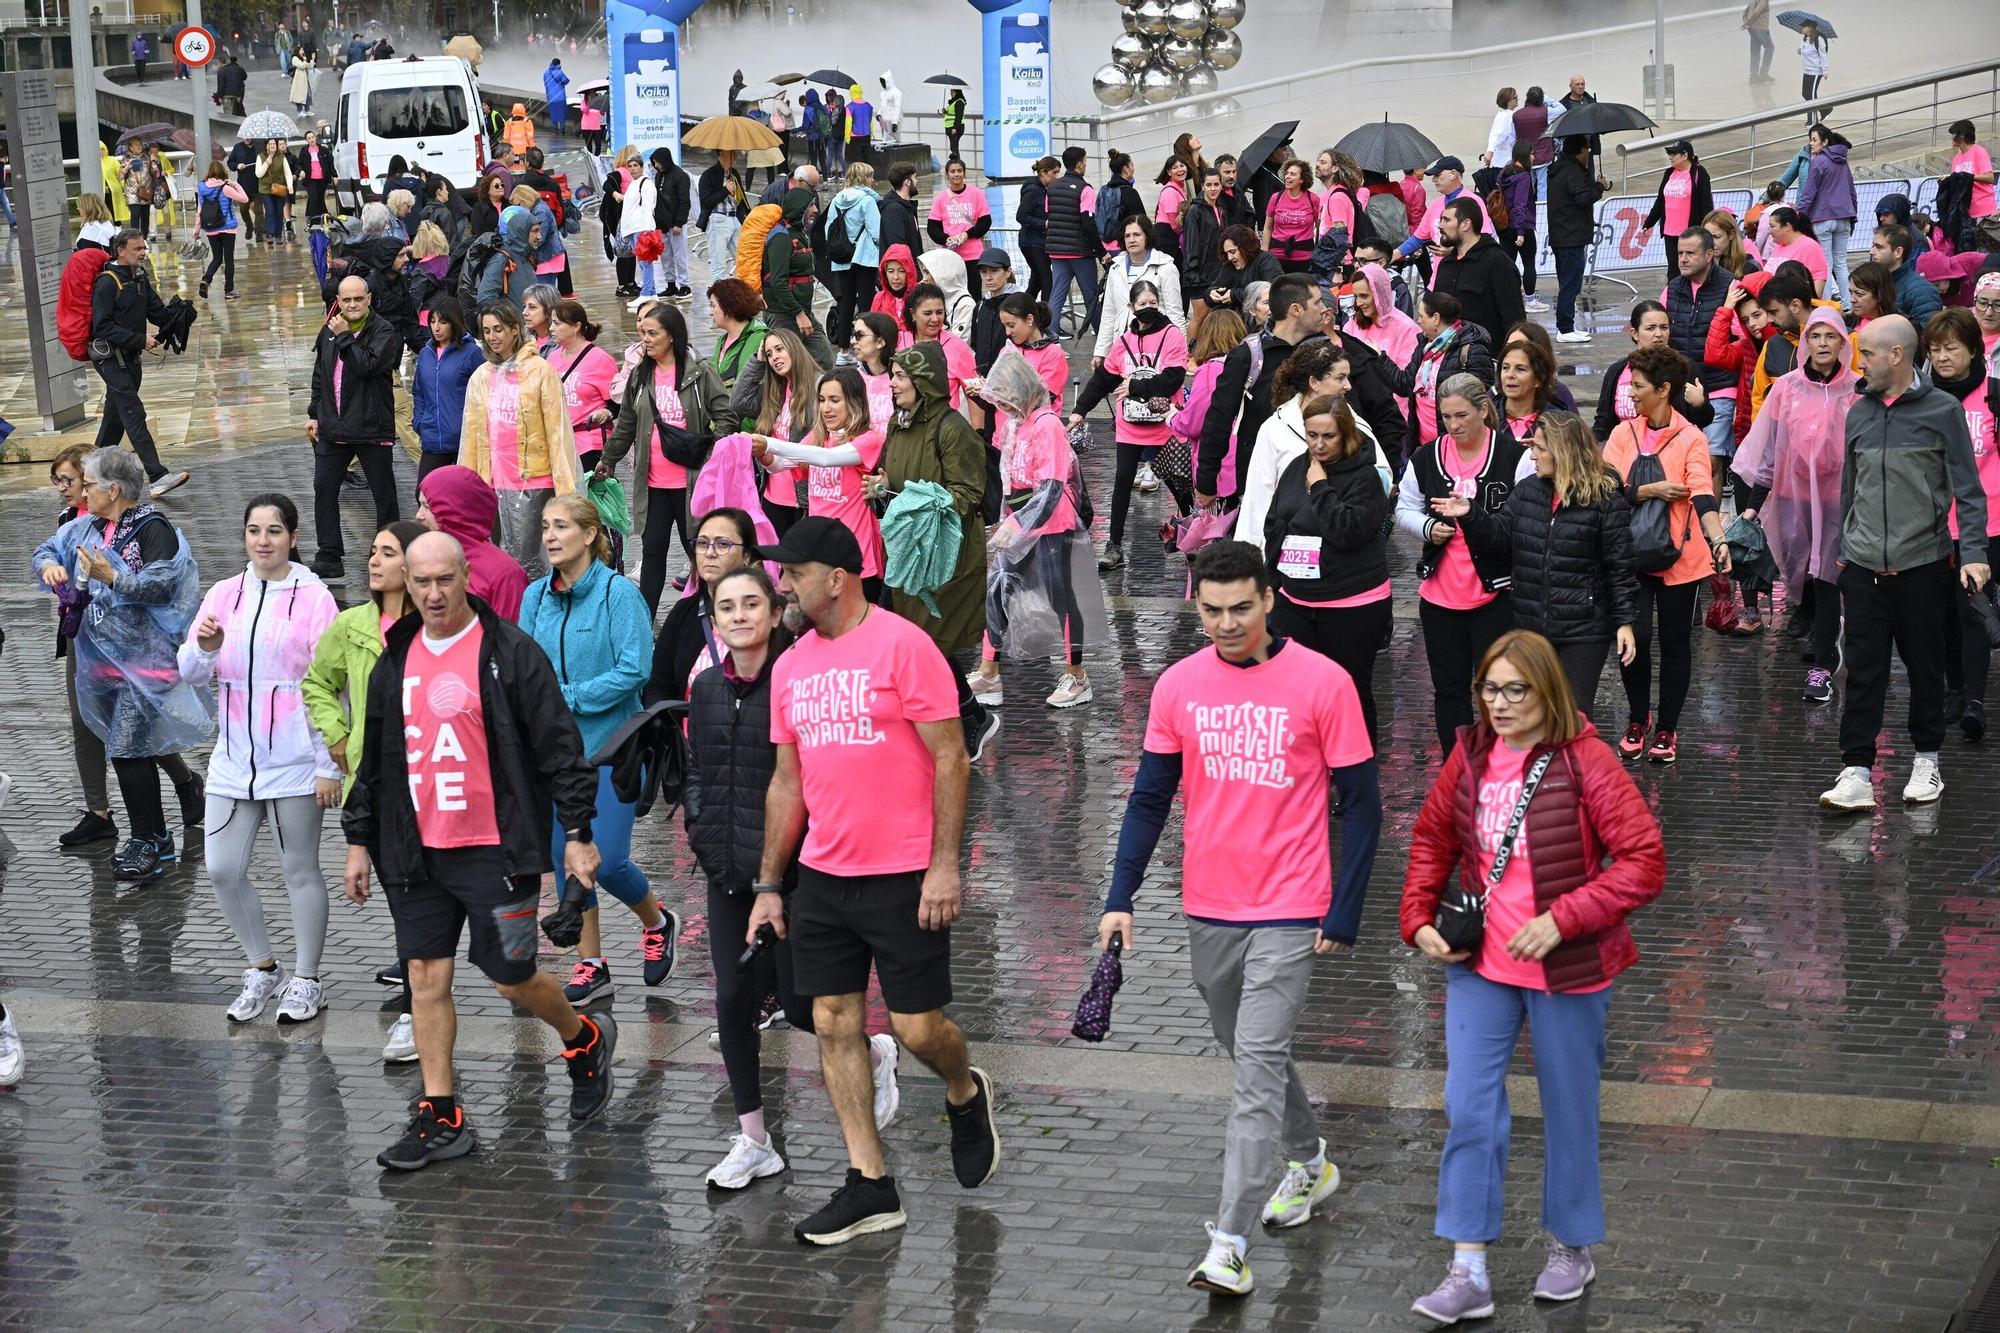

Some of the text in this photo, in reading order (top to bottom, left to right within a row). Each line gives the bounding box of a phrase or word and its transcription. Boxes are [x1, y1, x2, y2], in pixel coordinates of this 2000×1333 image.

[1014, 67, 1042, 79] Kaiku
[639, 86, 668, 98] Kaiku
[632, 115, 674, 125] Baserriko
[1283, 550, 1310, 563] 2025
